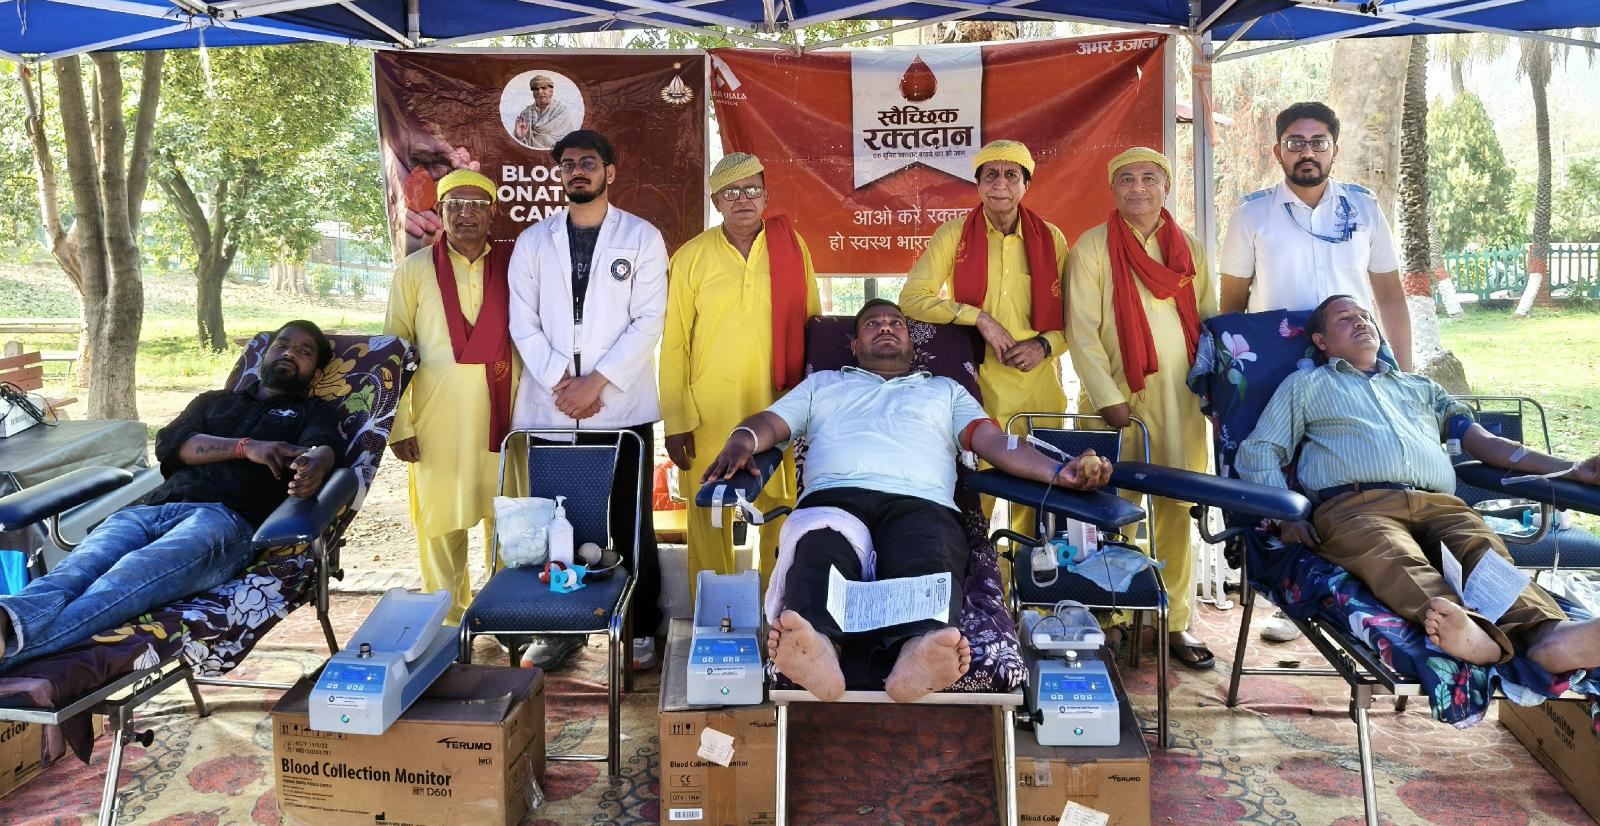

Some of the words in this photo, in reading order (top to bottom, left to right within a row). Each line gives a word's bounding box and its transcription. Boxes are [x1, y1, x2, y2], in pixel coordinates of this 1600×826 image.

[1076, 40, 1112, 55] अमर
[877, 105, 959, 126] स्वैच्छिक
[863, 126, 974, 150] रक्तदान
[502, 165, 561, 182] BLOO
[497, 185, 569, 202] ONAT
[510, 205, 569, 222] CAM
[852, 205, 893, 226] आओ
[897, 204, 921, 225] करें
[828, 231, 845, 251] हो
[849, 235, 892, 251] स्वस्थ
[1546, 701, 1575, 740] Monitor
[444, 740, 492, 751] TERUMO
[281, 757, 320, 776] Blood
[322, 761, 391, 782] Collection
[394, 767, 452, 786] Monitor
[670, 760, 689, 768] Blood
[729, 760, 748, 768] onitor
[426, 787, 452, 798] D601
[1042, 814, 1060, 822] Colle
